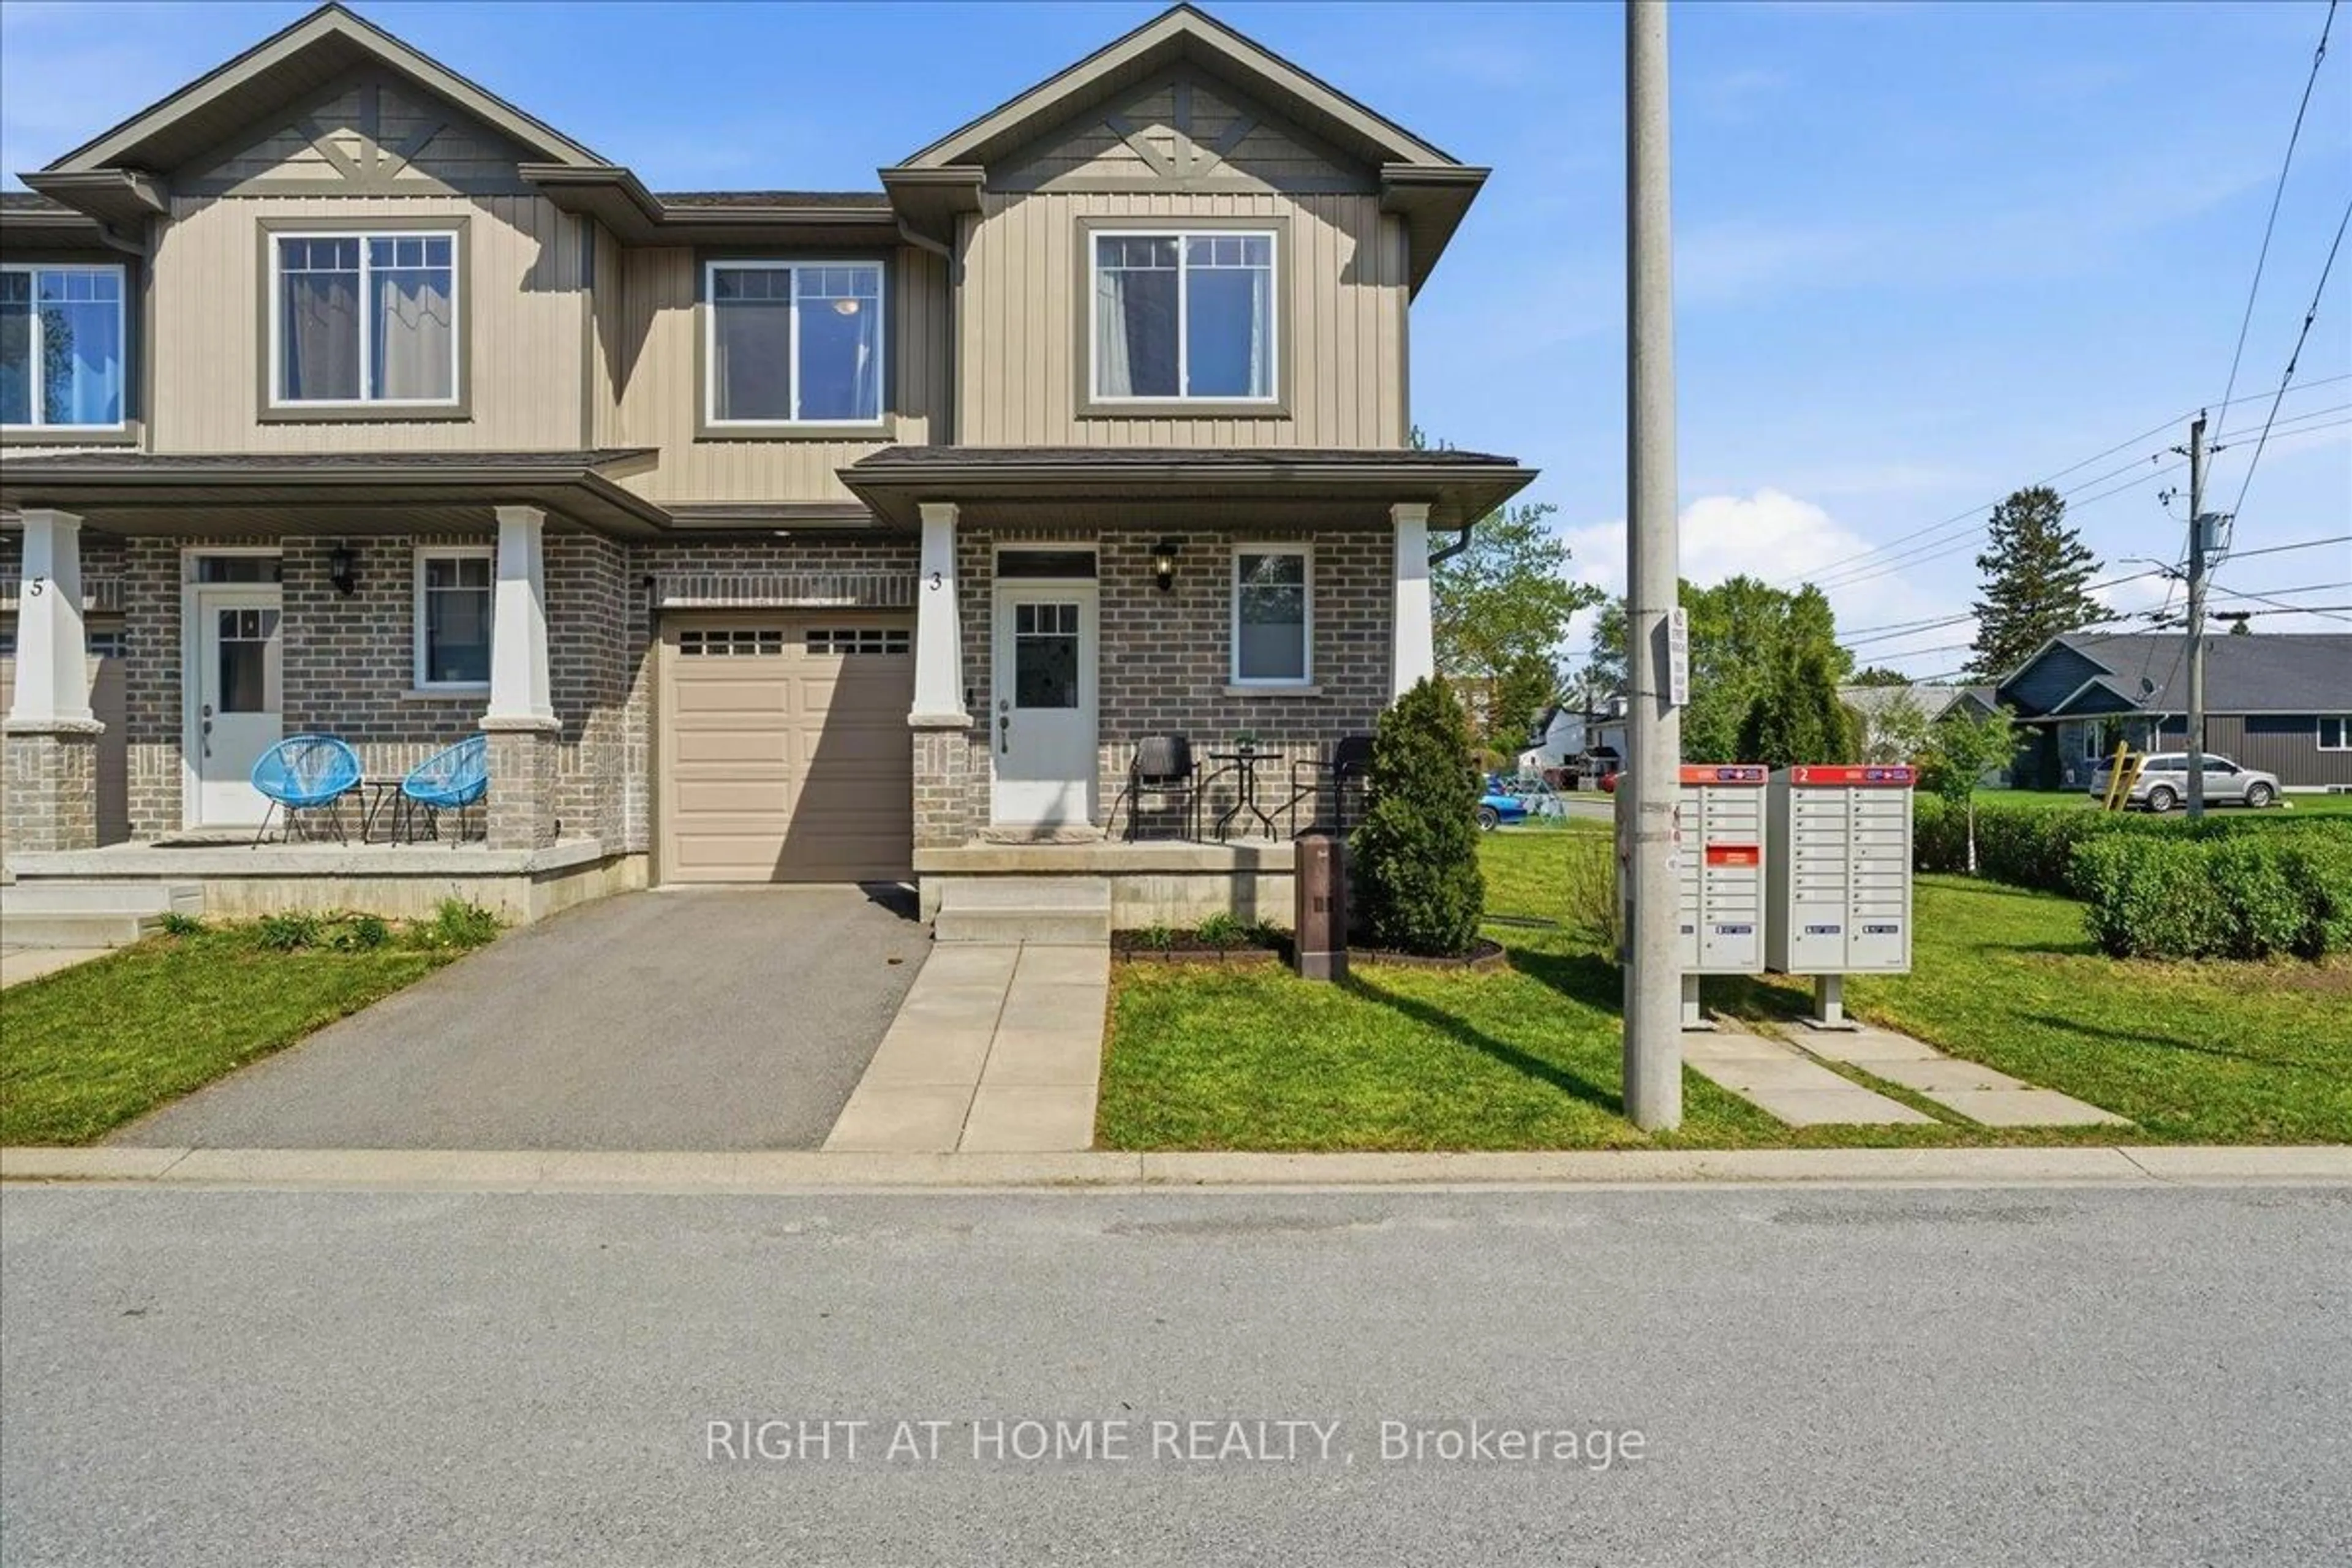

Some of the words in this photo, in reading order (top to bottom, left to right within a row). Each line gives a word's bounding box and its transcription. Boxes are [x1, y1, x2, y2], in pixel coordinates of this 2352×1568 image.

[30, 576, 44, 597] 5
[930, 571, 941, 591] 3
[1799, 767, 1807, 782] 2
